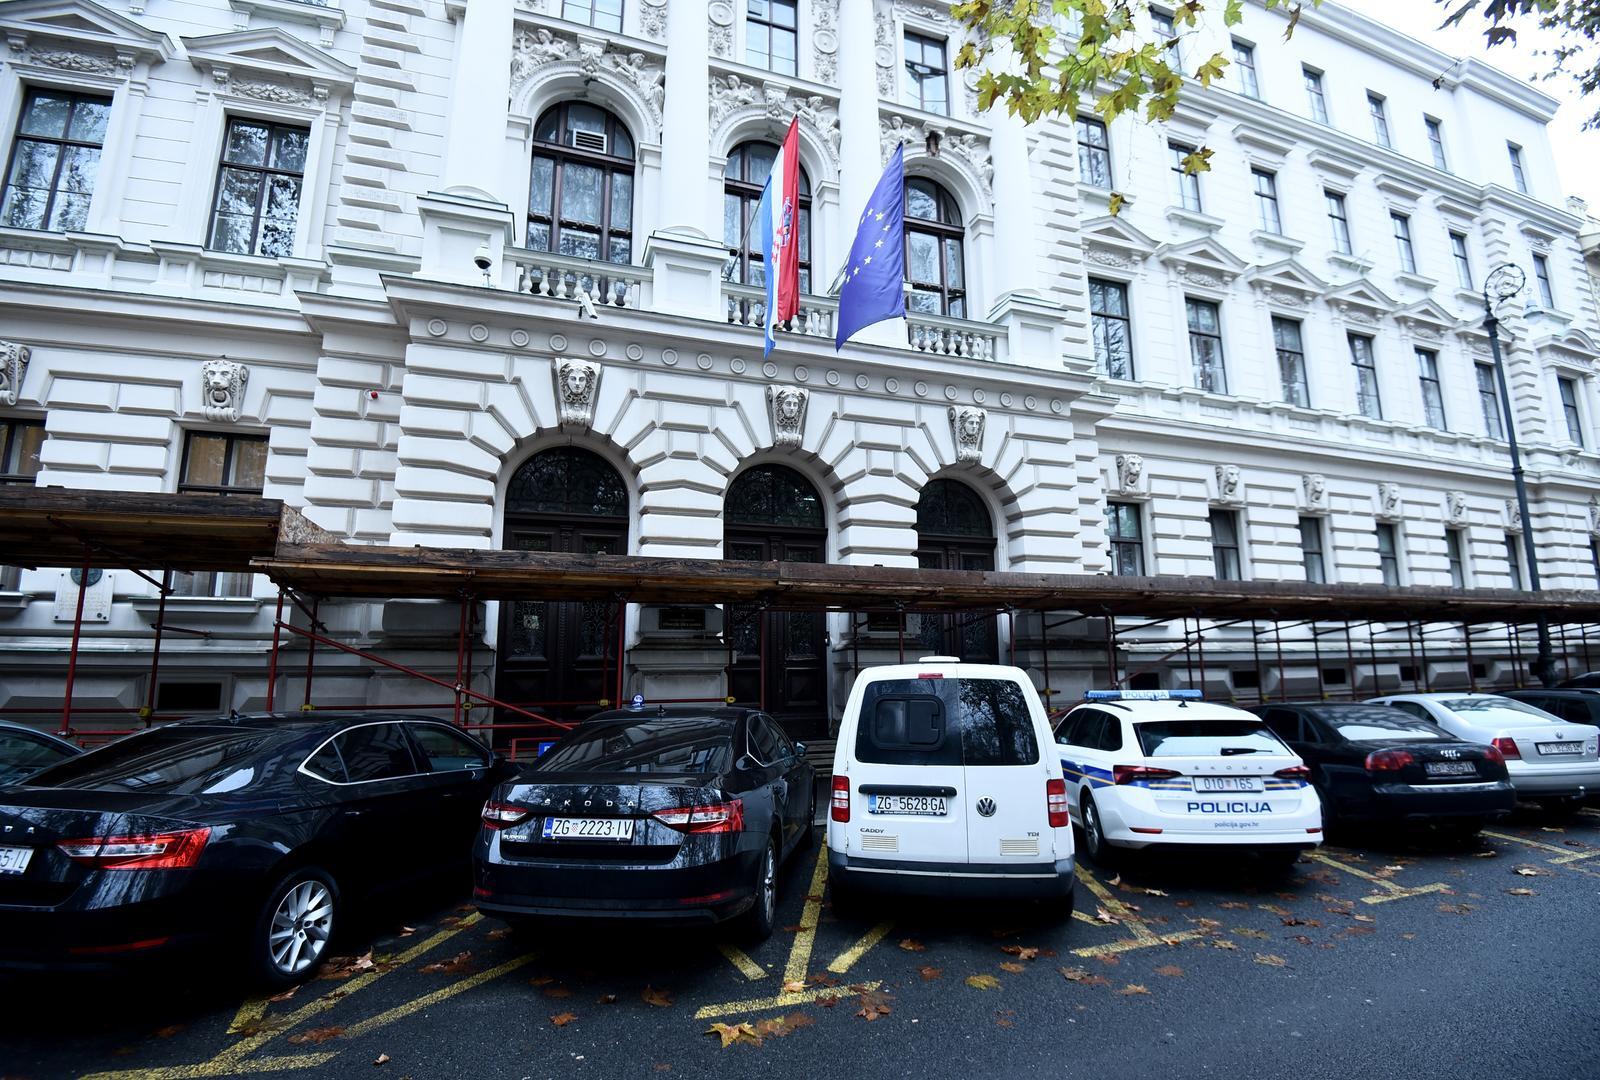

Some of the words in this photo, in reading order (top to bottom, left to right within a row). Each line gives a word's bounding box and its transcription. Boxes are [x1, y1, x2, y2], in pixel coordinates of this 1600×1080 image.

[1204, 778, 1224, 790] 010
[1234, 778, 1254, 790] 165
[877, 796, 892, 810] ZG
[1187, 802, 1272, 813] POLICIJA
[553, 819, 570, 835] ZG
